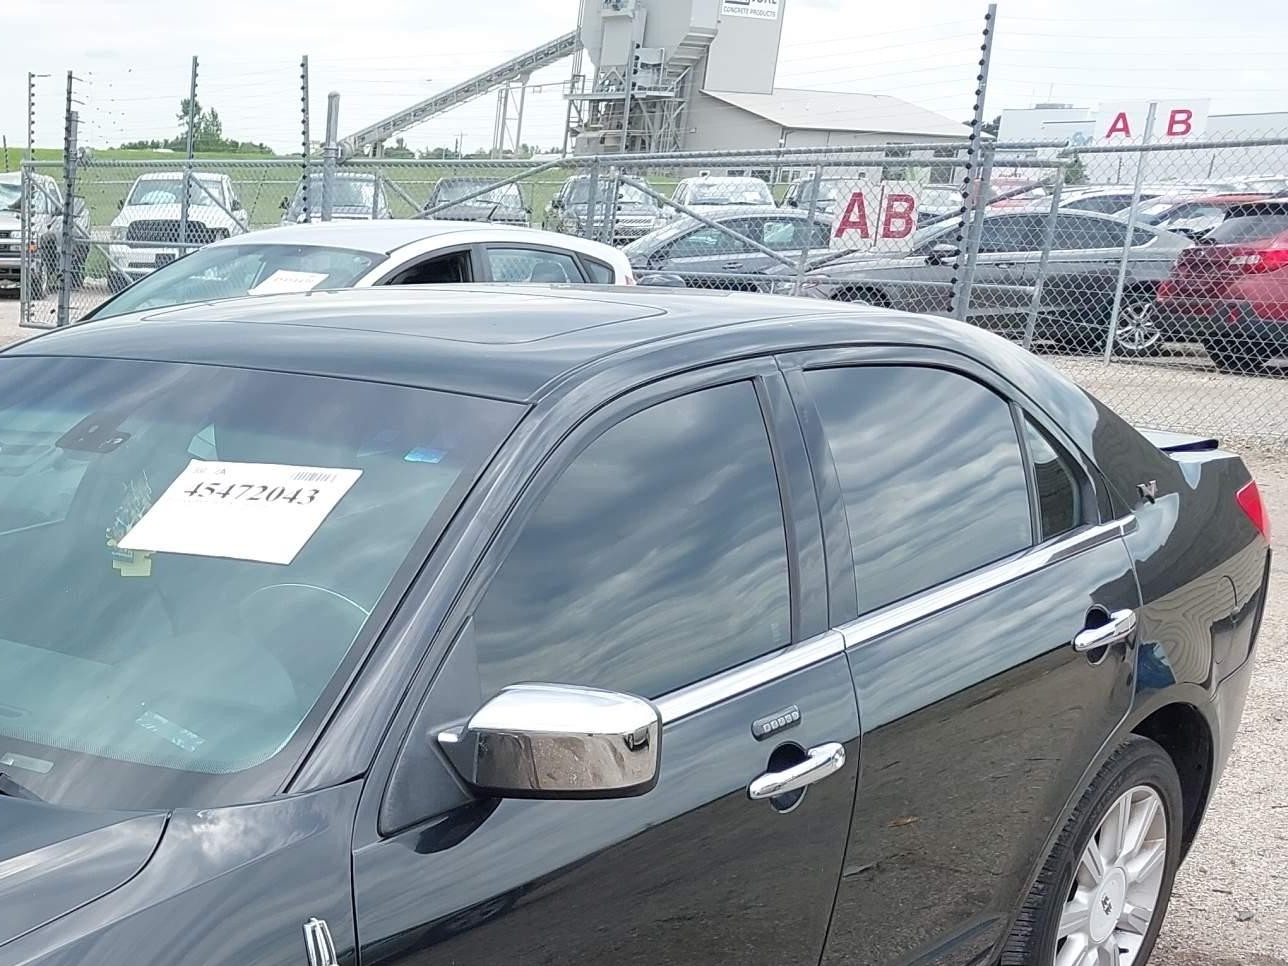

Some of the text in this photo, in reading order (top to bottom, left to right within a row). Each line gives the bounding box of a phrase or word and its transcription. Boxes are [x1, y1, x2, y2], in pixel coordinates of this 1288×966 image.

[723, 6, 777, 18] CONCRETE PRODUCTS
[1105, 109, 1193, 138] A B
[834, 191, 915, 239] A B
[184, 482, 320, 505] 45472043
